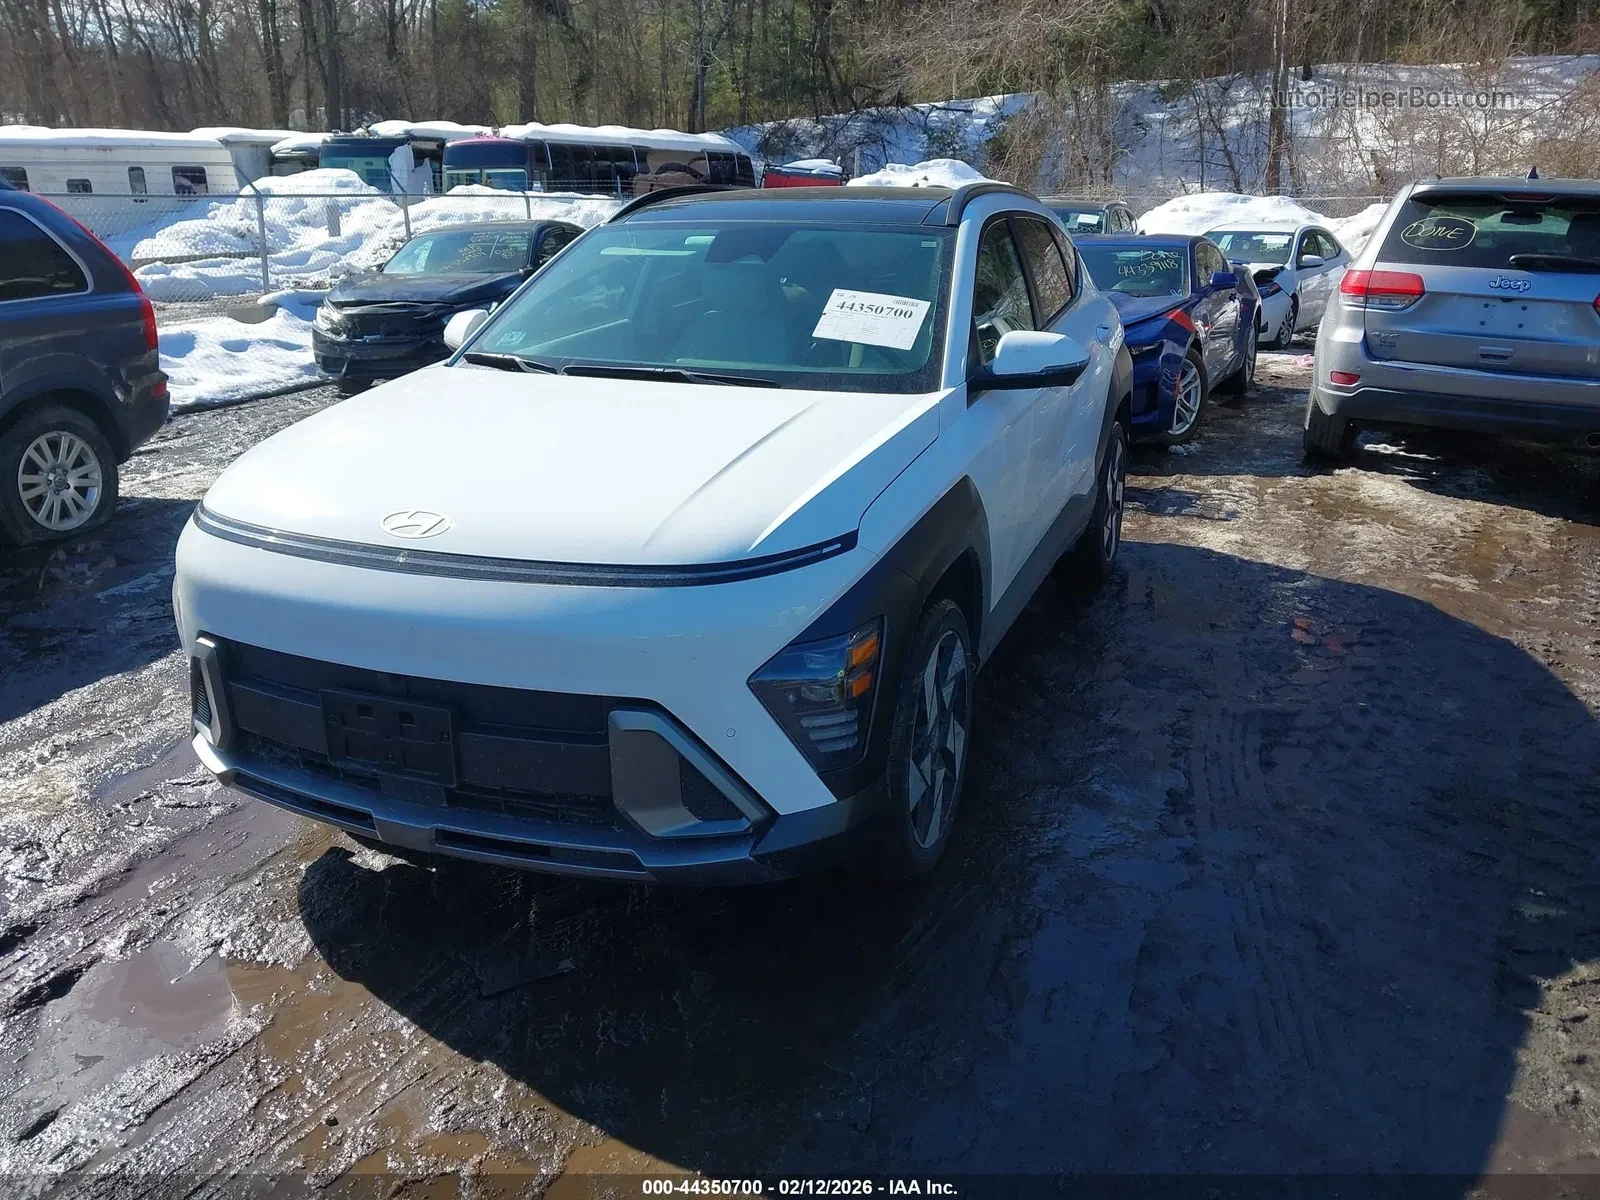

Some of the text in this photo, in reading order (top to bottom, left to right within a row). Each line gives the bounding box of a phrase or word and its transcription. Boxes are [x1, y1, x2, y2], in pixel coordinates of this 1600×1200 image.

[1404, 223, 1465, 239] DONE
[1489, 275, 1532, 293] Jeep
[836, 300, 914, 320] 44350700
